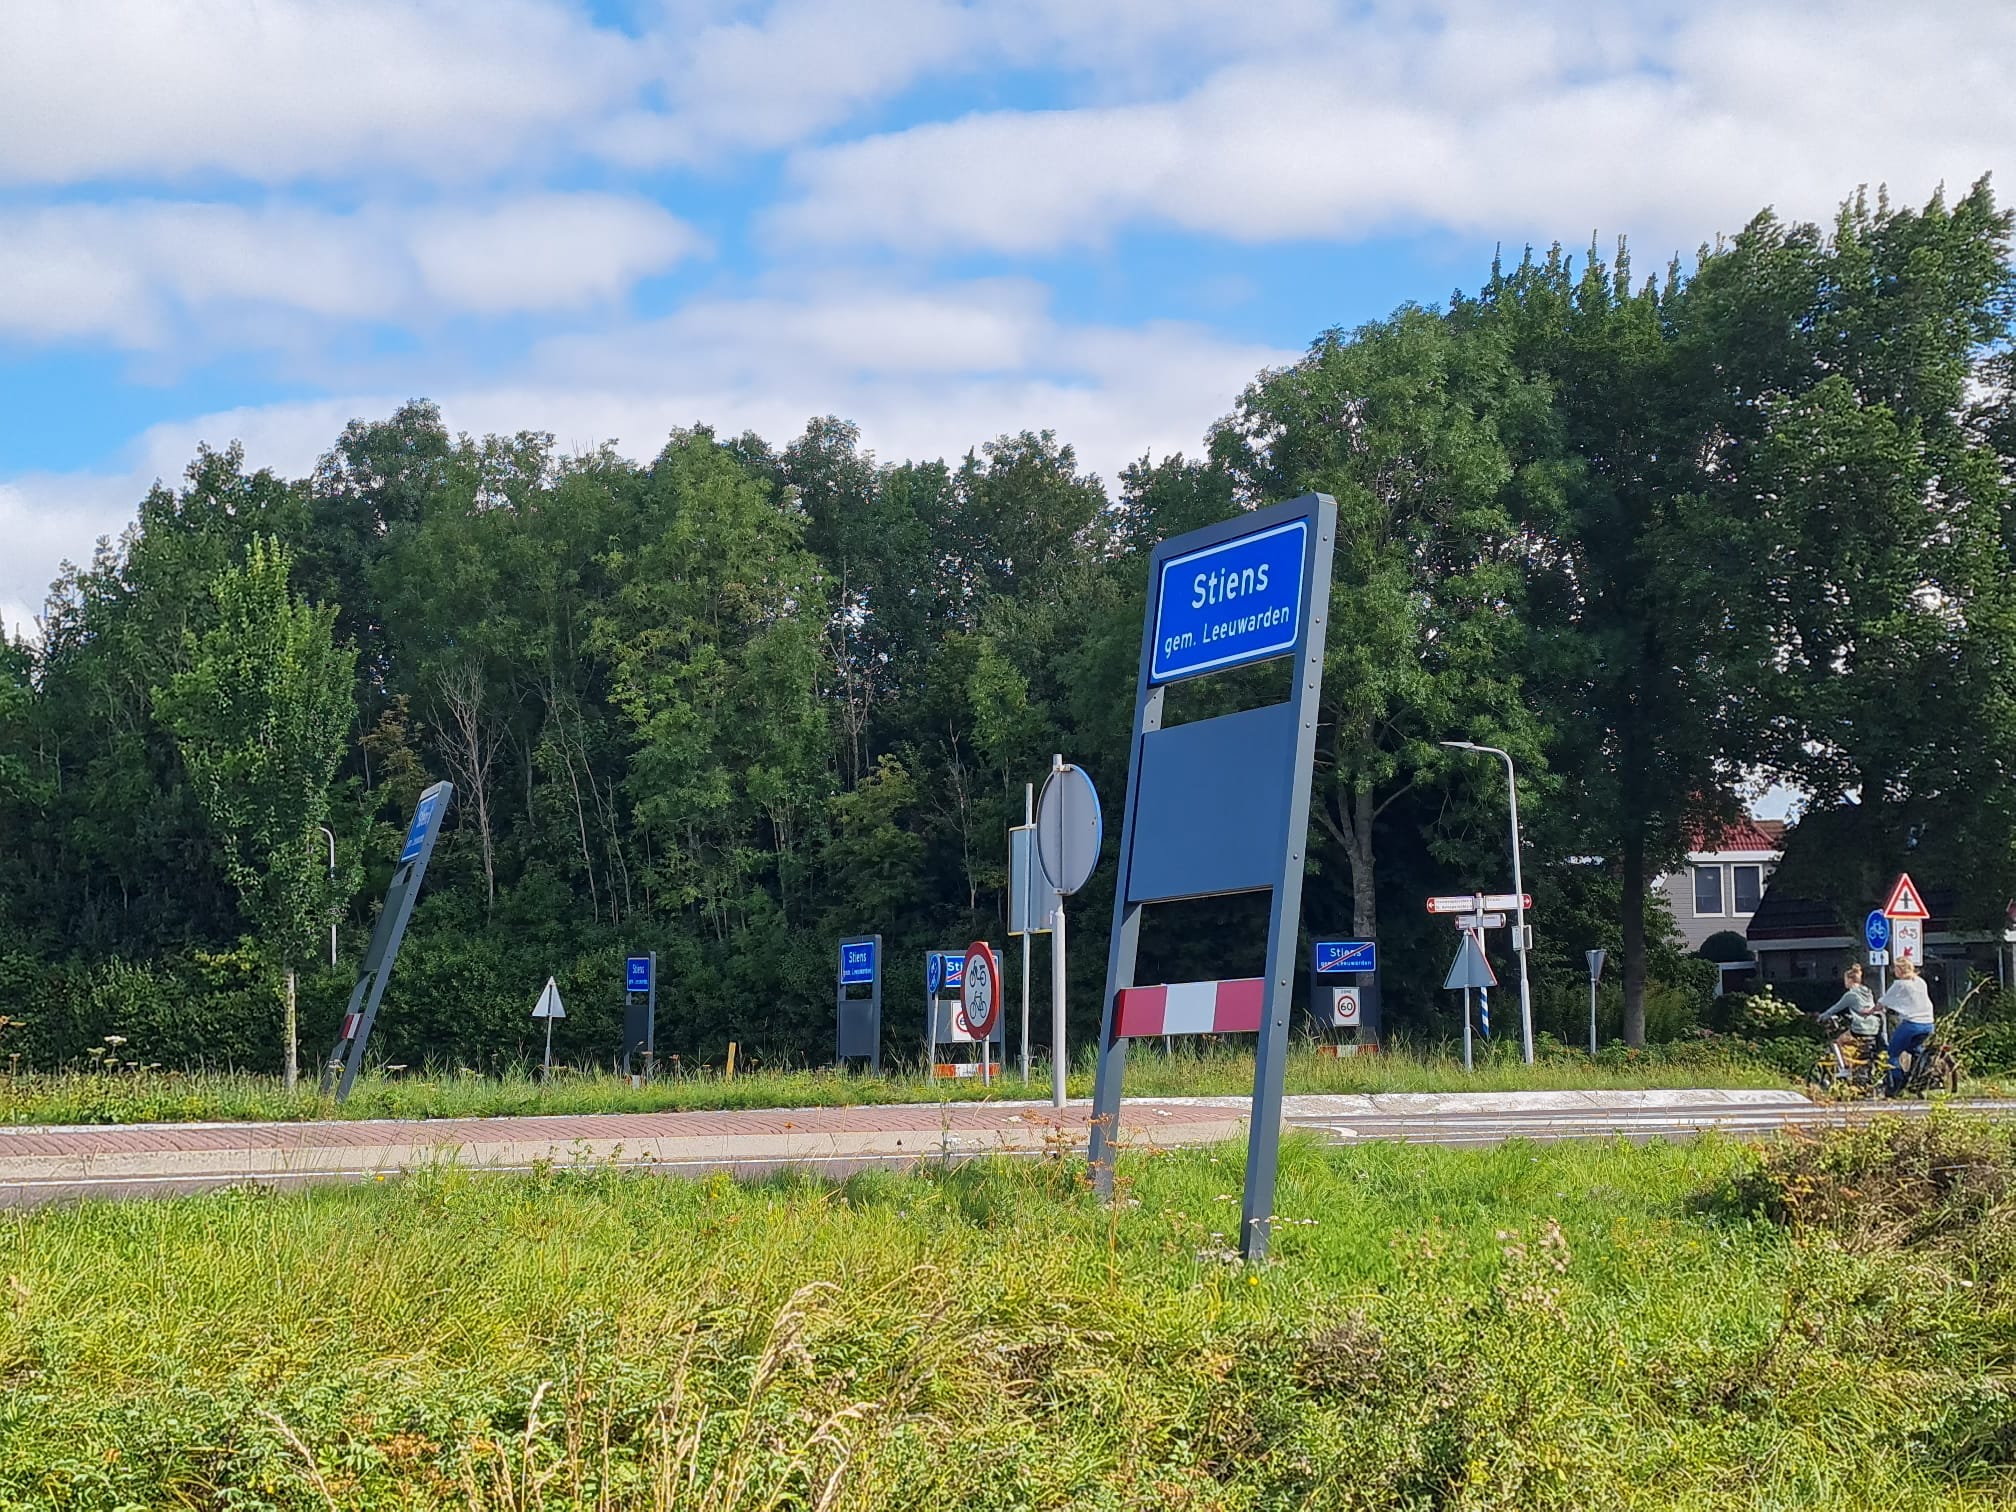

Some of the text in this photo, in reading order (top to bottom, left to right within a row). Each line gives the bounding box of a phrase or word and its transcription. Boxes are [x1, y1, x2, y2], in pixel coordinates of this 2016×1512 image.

[1191, 563, 1270, 609] Stiens
[1164, 606, 1290, 660] gem. Leeuwarden
[848, 951, 867, 964] Stiens
[1340, 1002, 1353, 1011] 60
